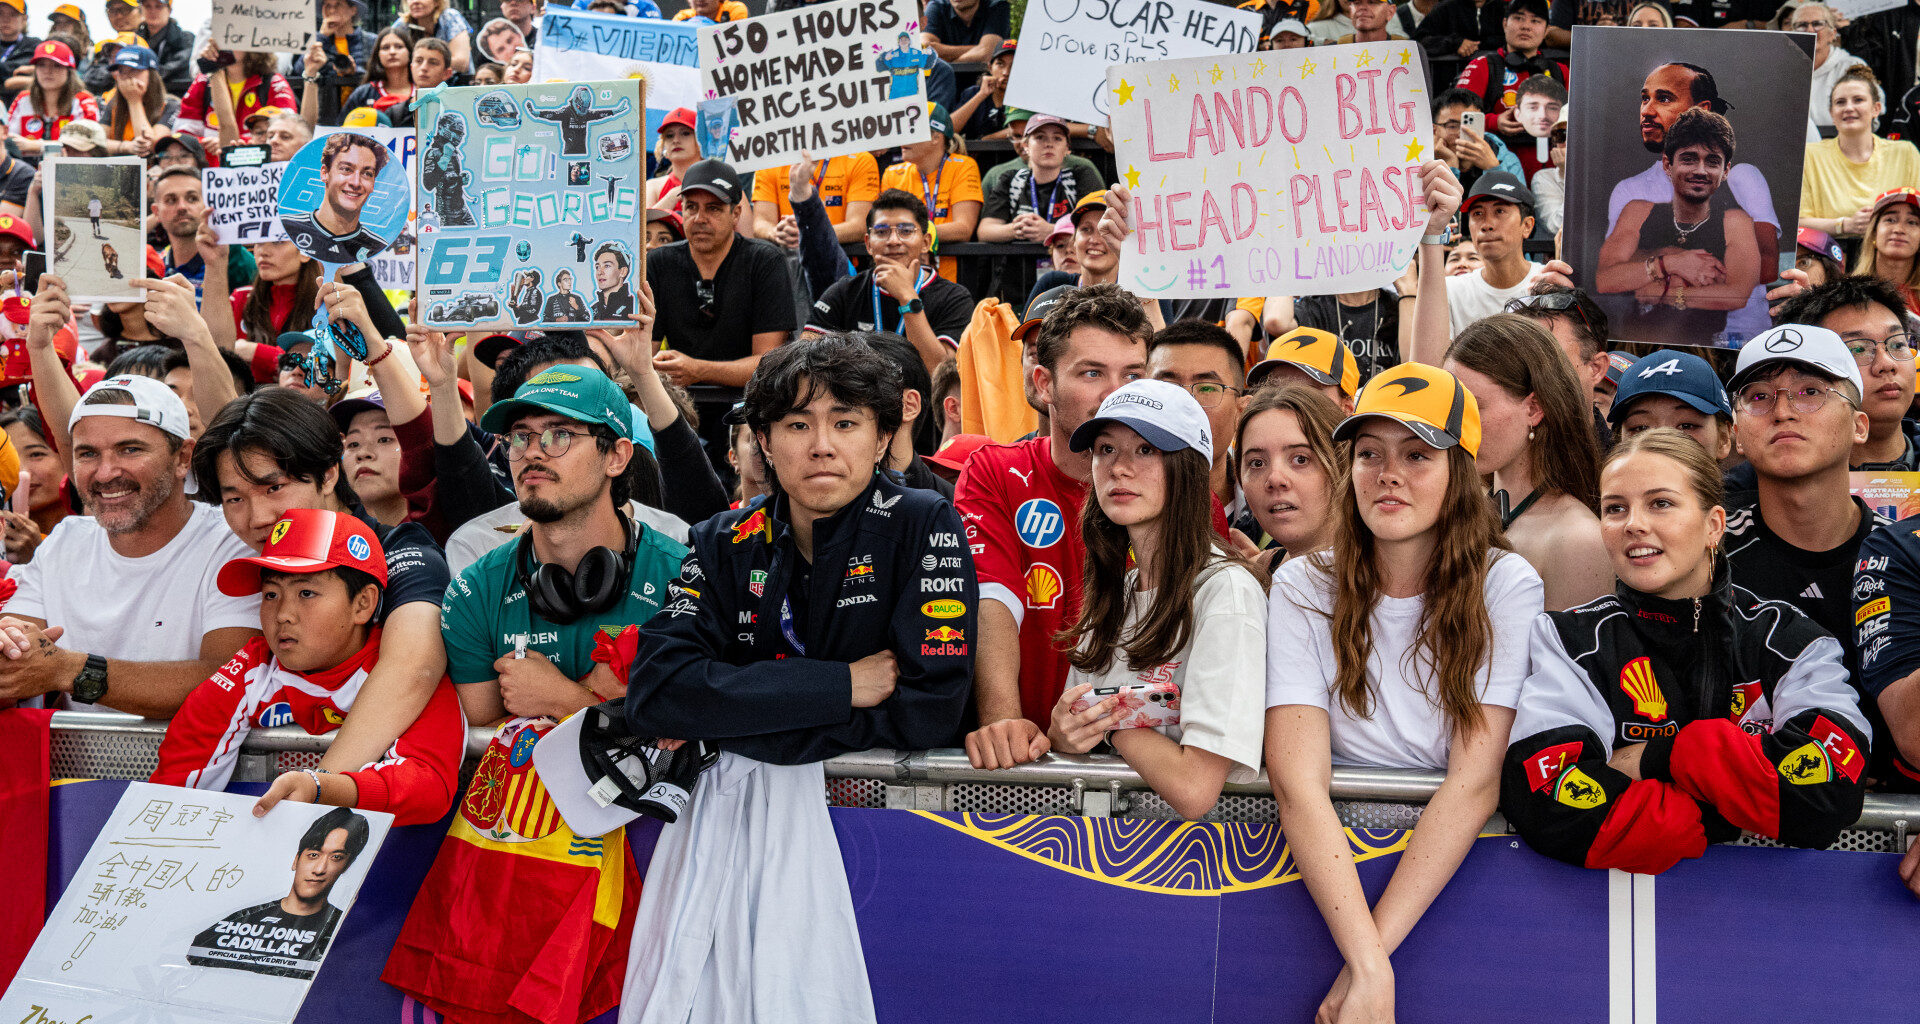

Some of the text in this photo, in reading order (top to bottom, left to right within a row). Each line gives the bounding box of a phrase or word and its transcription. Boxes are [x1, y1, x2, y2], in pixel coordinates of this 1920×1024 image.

[231, 4, 305, 20] Melbourne
[224, 24, 312, 51] for Lando!
[1040, 32, 1097, 55] Drove
[1104, 43, 1120, 62] 13
[1124, 31, 1169, 56] PLS
[711, 42, 865, 97] HOMEMADE
[1144, 66, 1416, 162] LANDO BIG
[728, 125, 807, 163] WORTH
[831, 105, 921, 145] SHOUT?
[236, 171, 257, 187] You
[212, 211, 243, 226] WENT
[482, 187, 636, 231] GEORGE
[1134, 182, 1258, 255] HEAD
[1290, 165, 1424, 238] PLEASE
[424, 236, 512, 284] 63
[1187, 254, 1231, 290] #1
[1248, 246, 1281, 284] GO
[559, 389, 579, 399] TEAM
[1102, 393, 1163, 411] Williams
[1021, 502, 1059, 547] hp
[350, 536, 368, 559] hp
[929, 532, 960, 548] VISA
[939, 557, 962, 568] AT&T
[920, 577, 964, 592] ROKT
[933, 604, 962, 613] RAUCH
[1857, 601, 1886, 622] PIRELLI
[921, 643, 968, 656] Red Bull
[1629, 725, 1676, 738] omp
[1823, 731, 1856, 766] F-1
[1537, 751, 1566, 779] F-1
[98, 851, 245, 893] 全中国人的
[214, 921, 317, 944] ZHOU JOINS
[216, 934, 304, 956] CADILLAC
[208, 950, 238, 959] OFFICIAL
[271, 956, 298, 967] DRIVER
